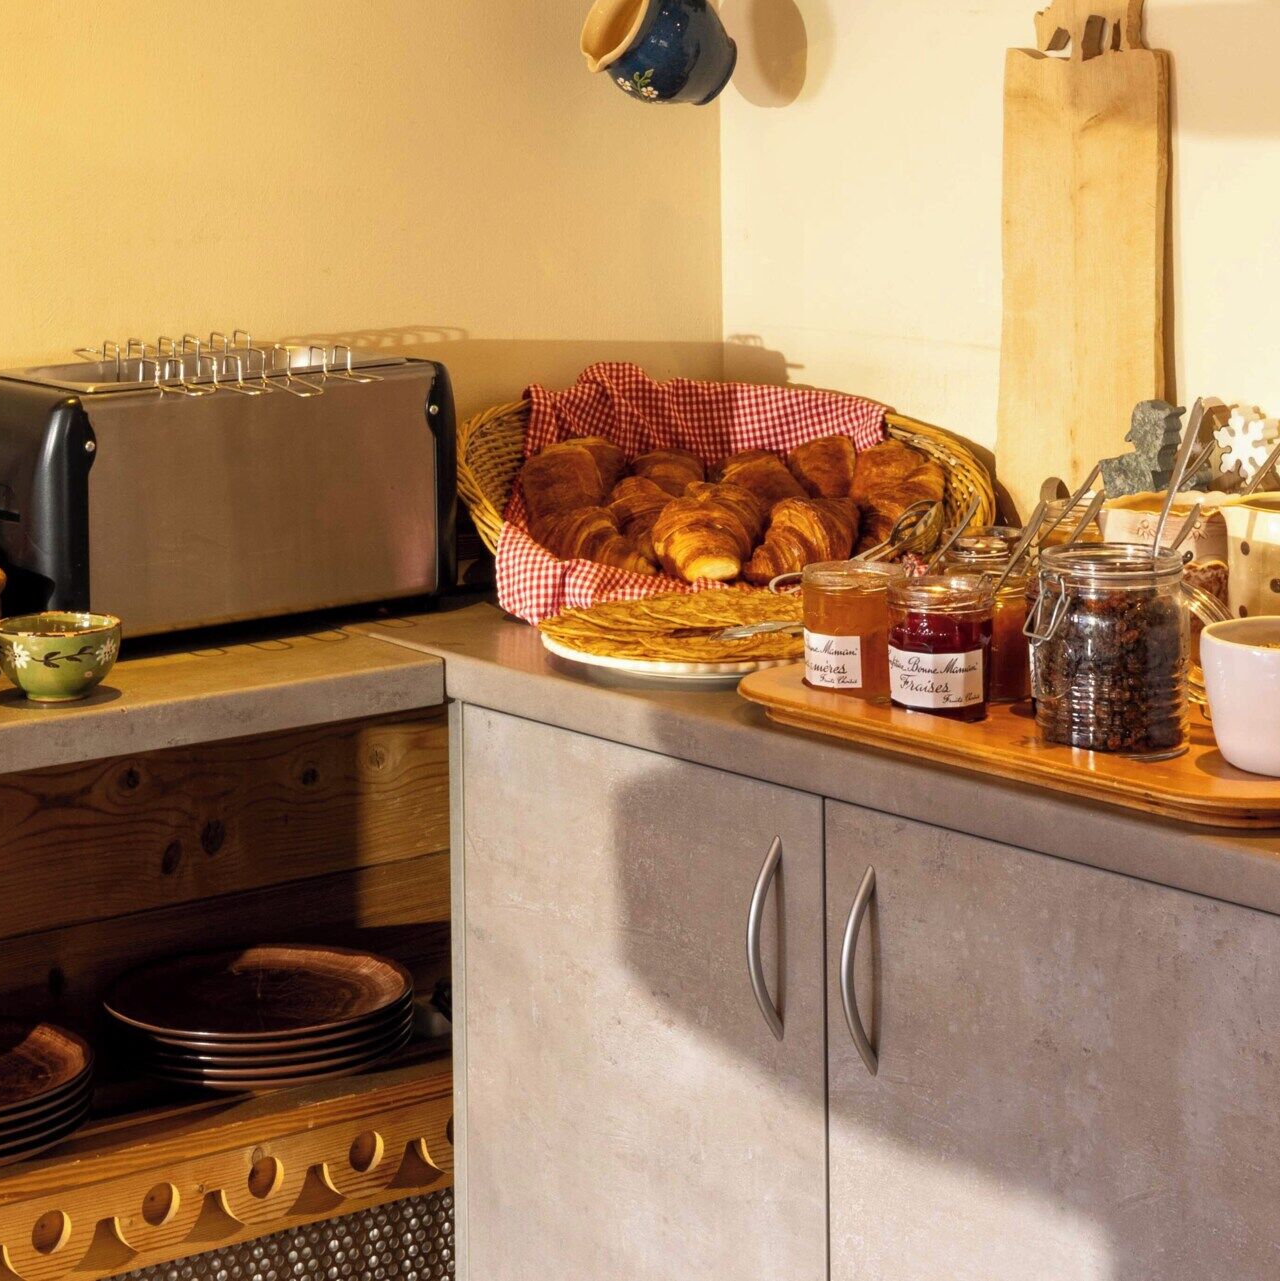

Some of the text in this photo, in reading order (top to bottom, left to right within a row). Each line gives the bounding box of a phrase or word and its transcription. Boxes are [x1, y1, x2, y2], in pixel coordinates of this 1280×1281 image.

[907, 656, 939, 675] Bonne
[940, 657, 978, 674] Maman
[900, 673, 951, 694] Fraises
